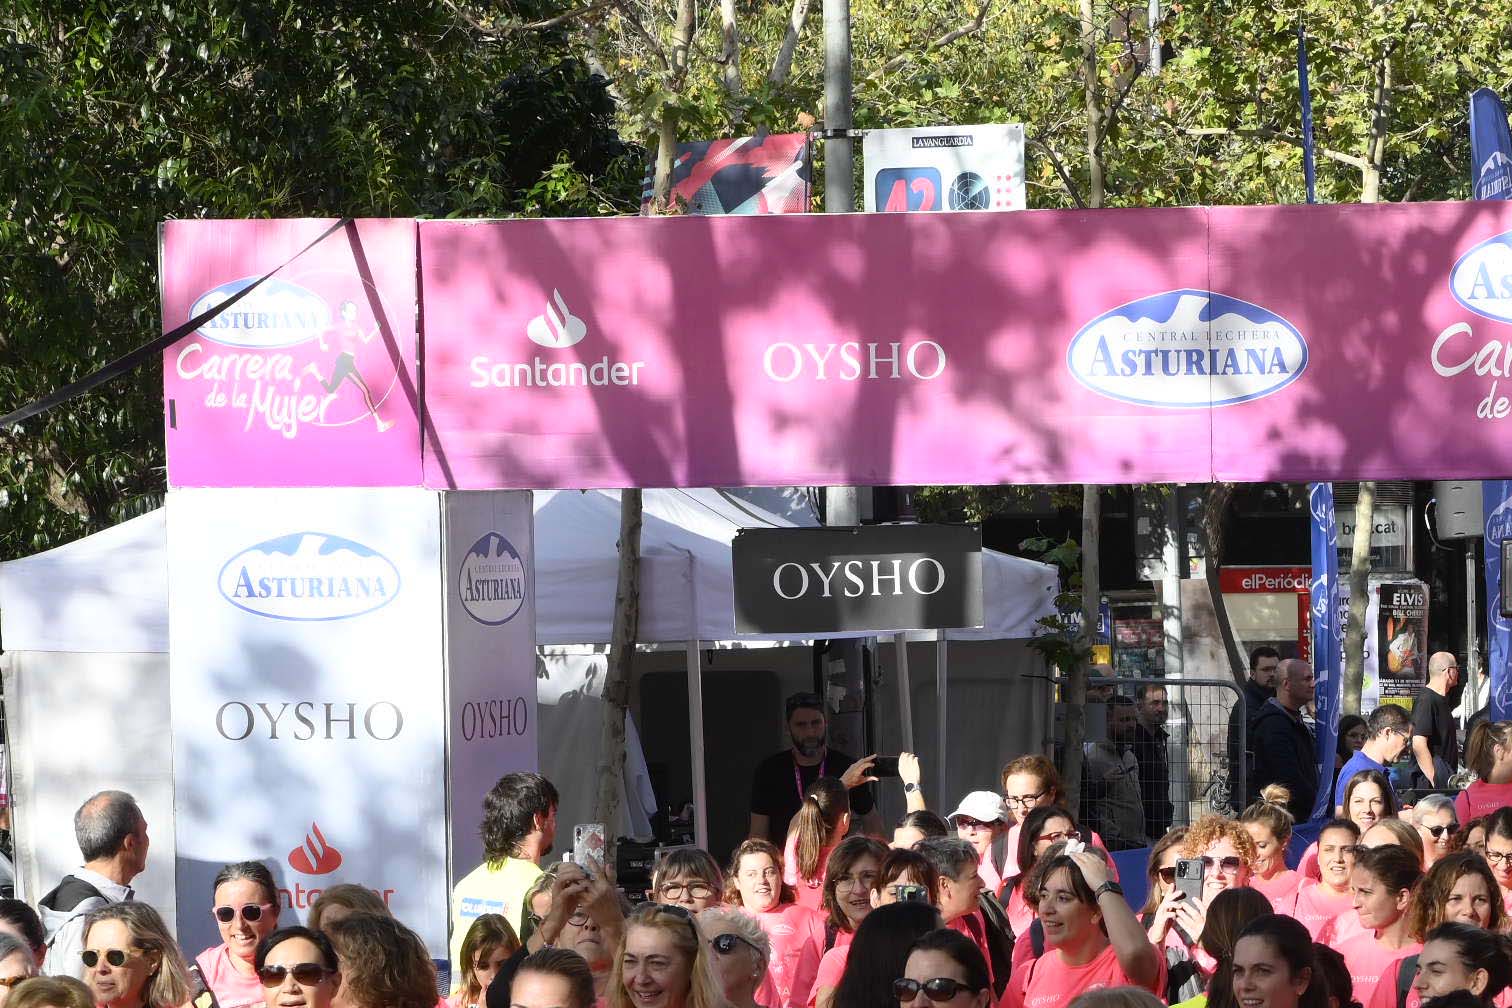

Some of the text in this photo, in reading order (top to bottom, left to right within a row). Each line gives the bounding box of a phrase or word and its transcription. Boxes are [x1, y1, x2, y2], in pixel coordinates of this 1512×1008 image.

[1123, 330, 1281, 342] CENTRAL LECHERA
[176, 343, 295, 381] Carrera
[470, 356, 645, 388] Santander
[763, 340, 947, 382] OYSHO
[1089, 335, 1290, 377] ASTURIANA
[205, 373, 338, 439] de la Mujer
[1476, 380, 1510, 419] de
[234, 565, 387, 599] ASTURIANA
[465, 567, 523, 601] ASTURIANA
[773, 558, 945, 600] OYSHO
[1393, 592, 1423, 607] ELVIS
[215, 701, 404, 742] OYSHO
[462, 697, 528, 742] OYSHO
